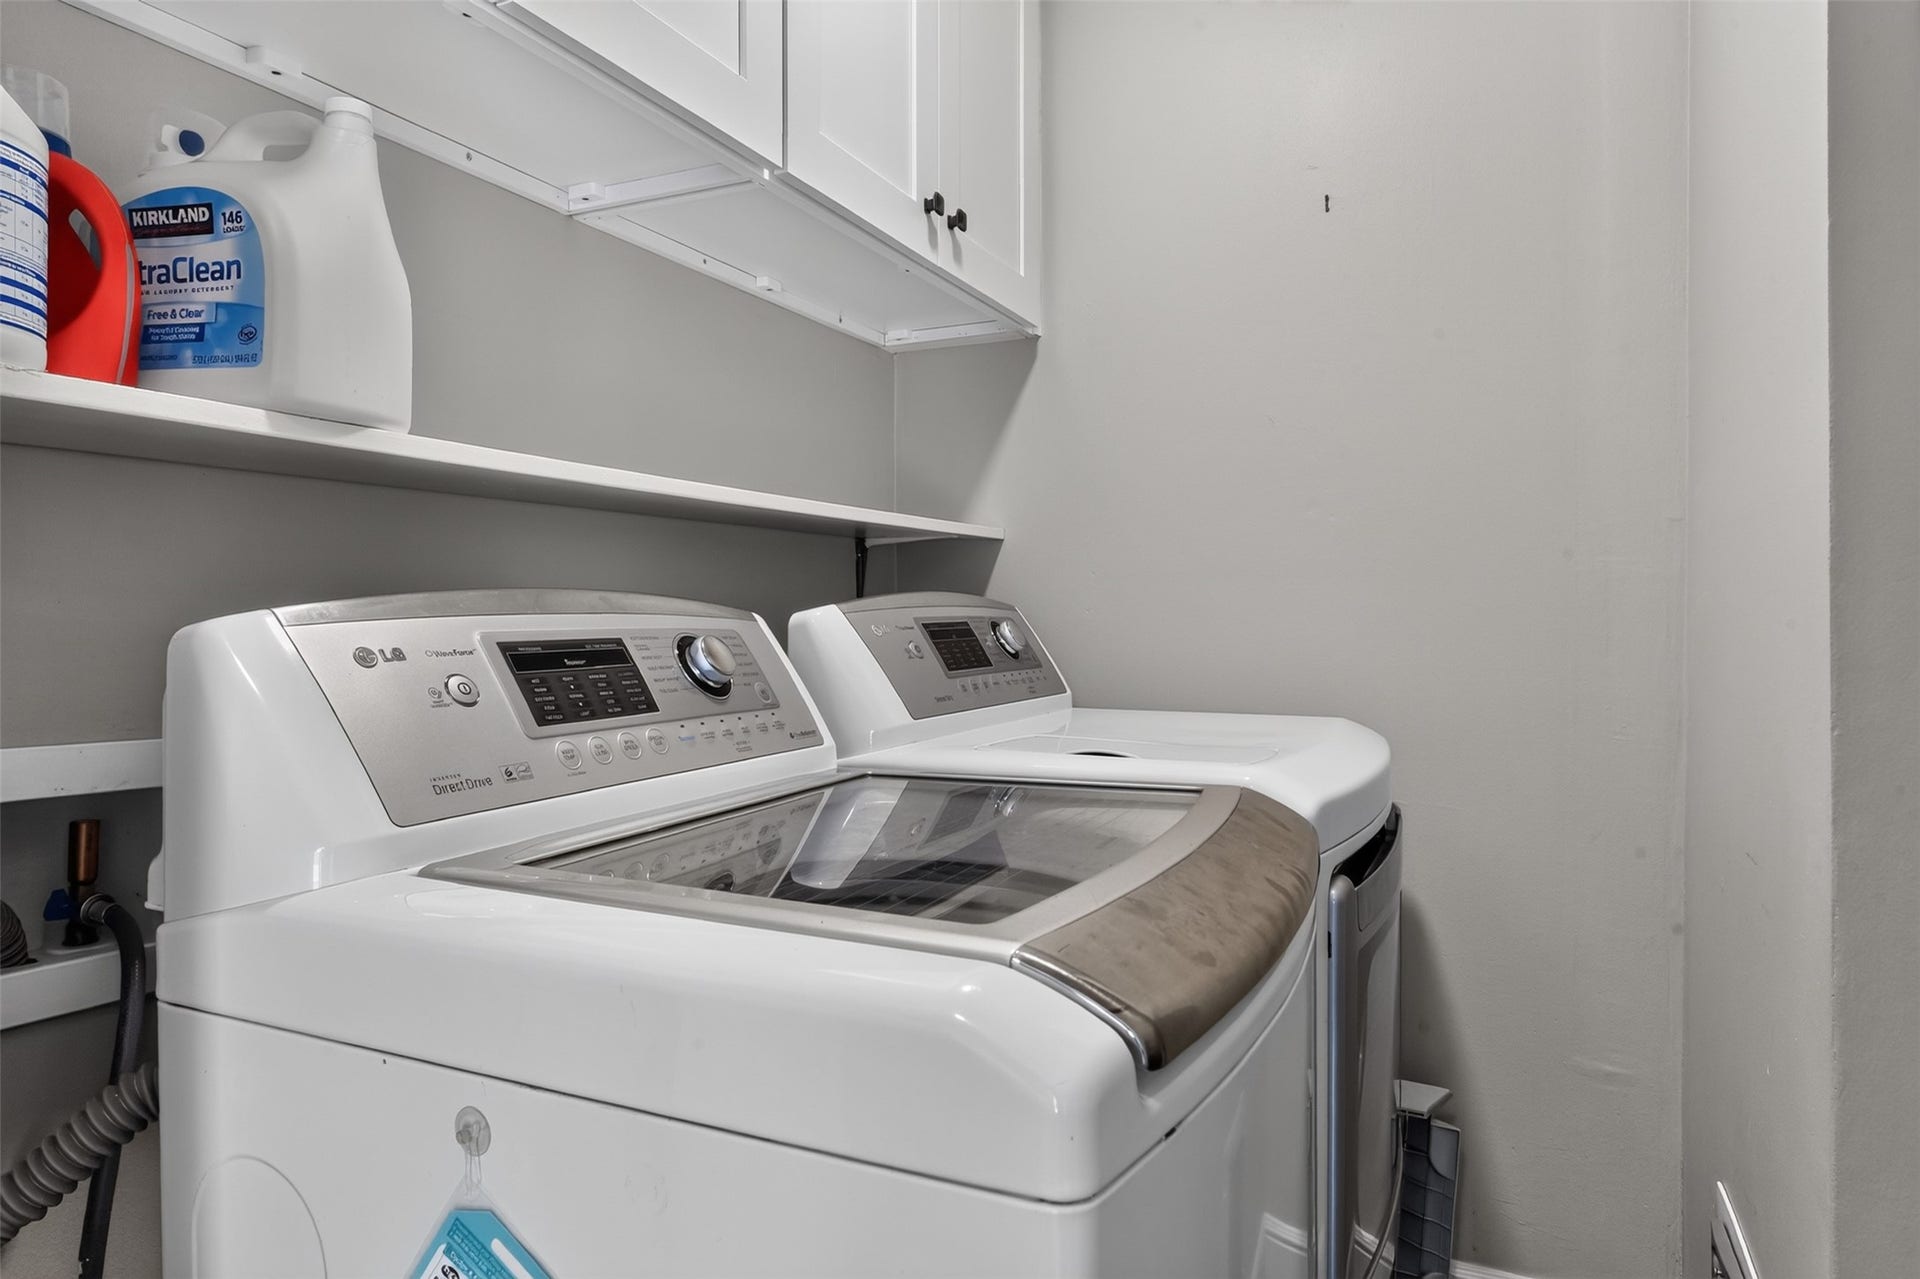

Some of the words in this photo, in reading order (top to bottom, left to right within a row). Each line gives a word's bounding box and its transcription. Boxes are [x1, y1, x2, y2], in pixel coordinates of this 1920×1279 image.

[132, 207, 210, 227] KIRKLAND
[221, 211, 243, 226] 146
[147, 309, 169, 320] Free
[169, 308, 177, 319] &
[178, 307, 205, 319] Clear
[378, 647, 407, 663] LG
